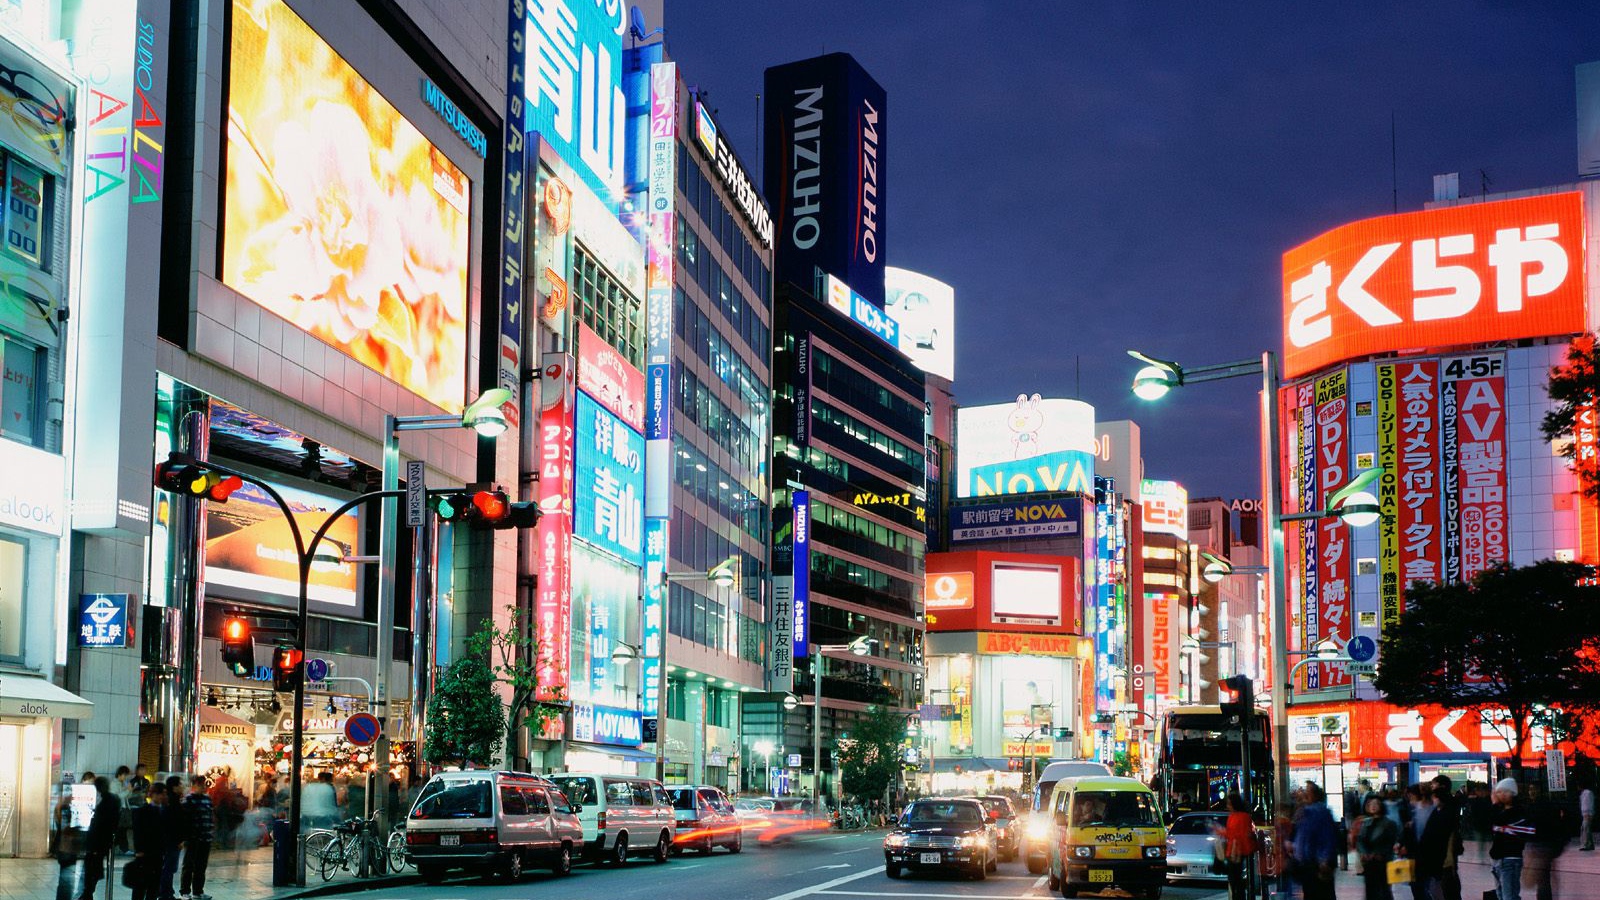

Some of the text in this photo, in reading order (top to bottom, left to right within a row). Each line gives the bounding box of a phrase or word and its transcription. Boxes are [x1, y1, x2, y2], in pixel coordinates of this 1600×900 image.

[137, 18, 154, 91] STUDIO
[426, 79, 487, 159] MITSUBISHI
[132, 88, 163, 204] ALTA
[793, 85, 823, 249] MIZUHO
[864, 99, 878, 263] MIZUHO
[1289, 223, 1569, 348] さくらや
[855, 298, 895, 340] UCカード
[799, 339, 807, 374] MIZUHO
[1299, 384, 1313, 407] 2F
[1317, 384, 1346, 406] AV製品
[544, 425, 561, 478] アコム
[595, 409, 641, 474] 洋服の
[1460, 381, 1504, 504] AV製品
[410, 464, 421, 524] スクランブル交差点
[976, 460, 1090, 497] NOVA
[593, 466, 641, 556] 青山
[796, 504, 806, 544] MIZUHO
[962, 504, 1067, 524] 駅前留学 NOVA
[81, 624, 122, 637] 地下鉄
[86, 636, 116, 644] SUBWAY
[775, 586, 790, 677] 三井住友銀行
[985, 633, 1072, 652] ABC-MART
[21, 703, 48, 715] alook
[595, 711, 641, 740] AOYAMA
[225, 726, 248, 735] DOLL
